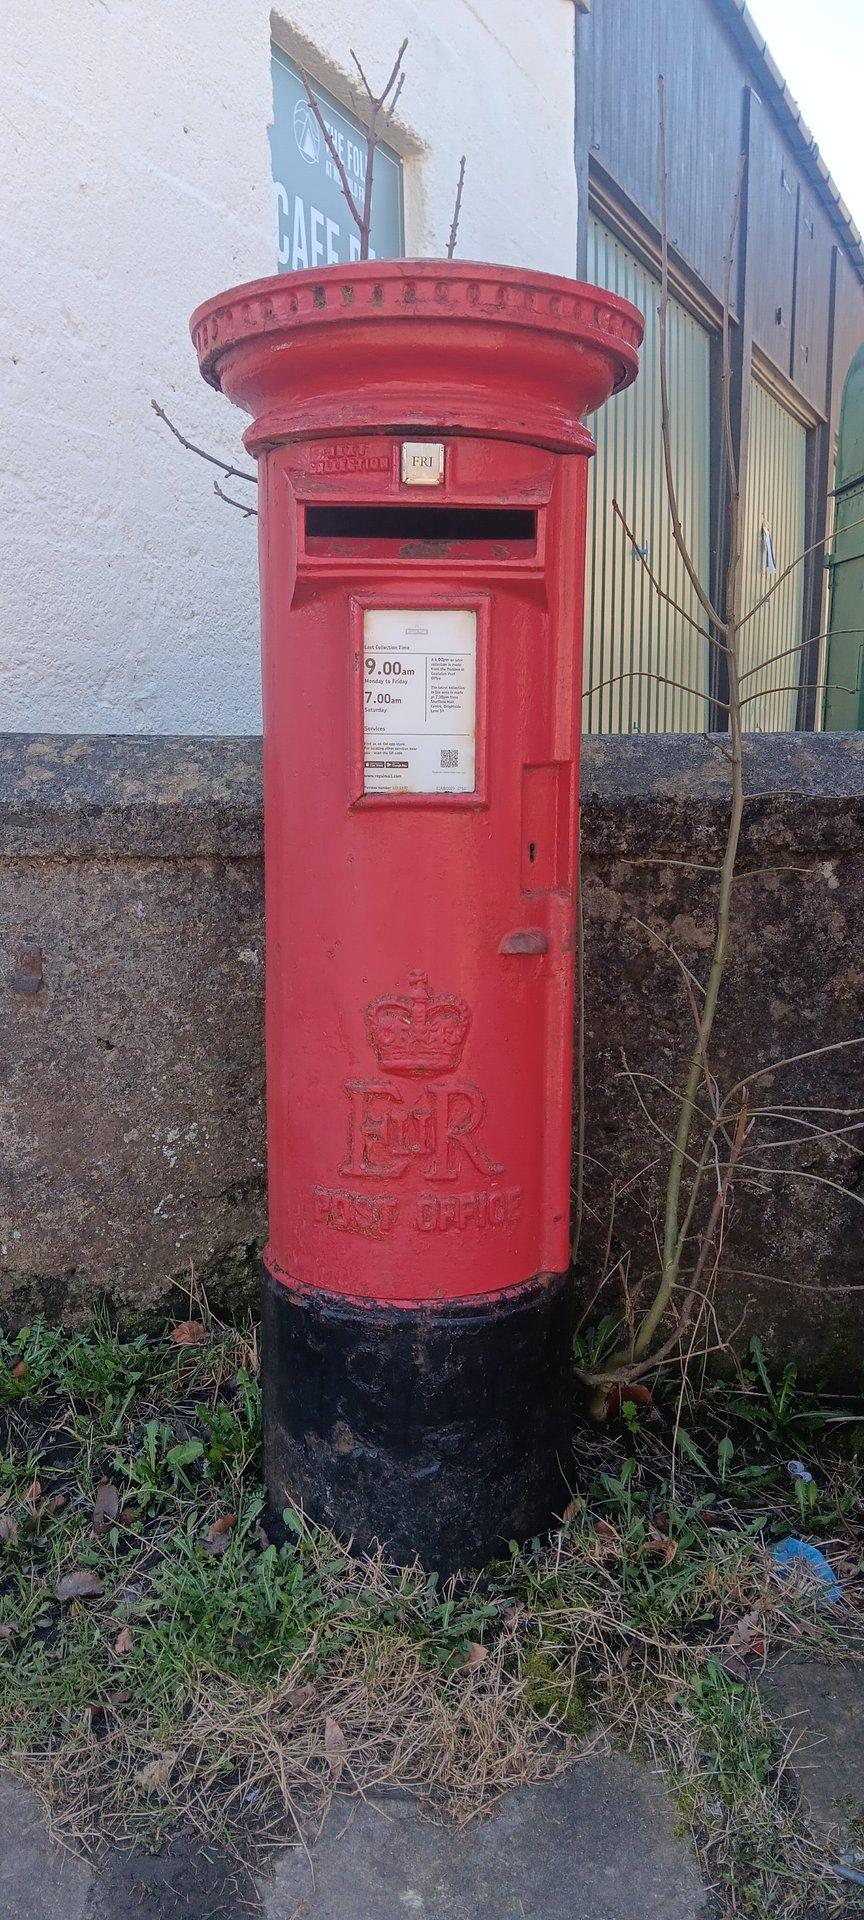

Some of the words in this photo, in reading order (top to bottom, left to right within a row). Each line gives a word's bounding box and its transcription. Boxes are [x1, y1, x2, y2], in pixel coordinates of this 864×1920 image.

[274, 181, 340, 271] CAFE
[411, 455, 434, 468] FRI
[365, 657, 415, 675] 9.00am
[365, 691, 402, 704] 7.00am
[312, 1185, 399, 1240] POST
[415, 1185, 522, 1232] OFFICE
